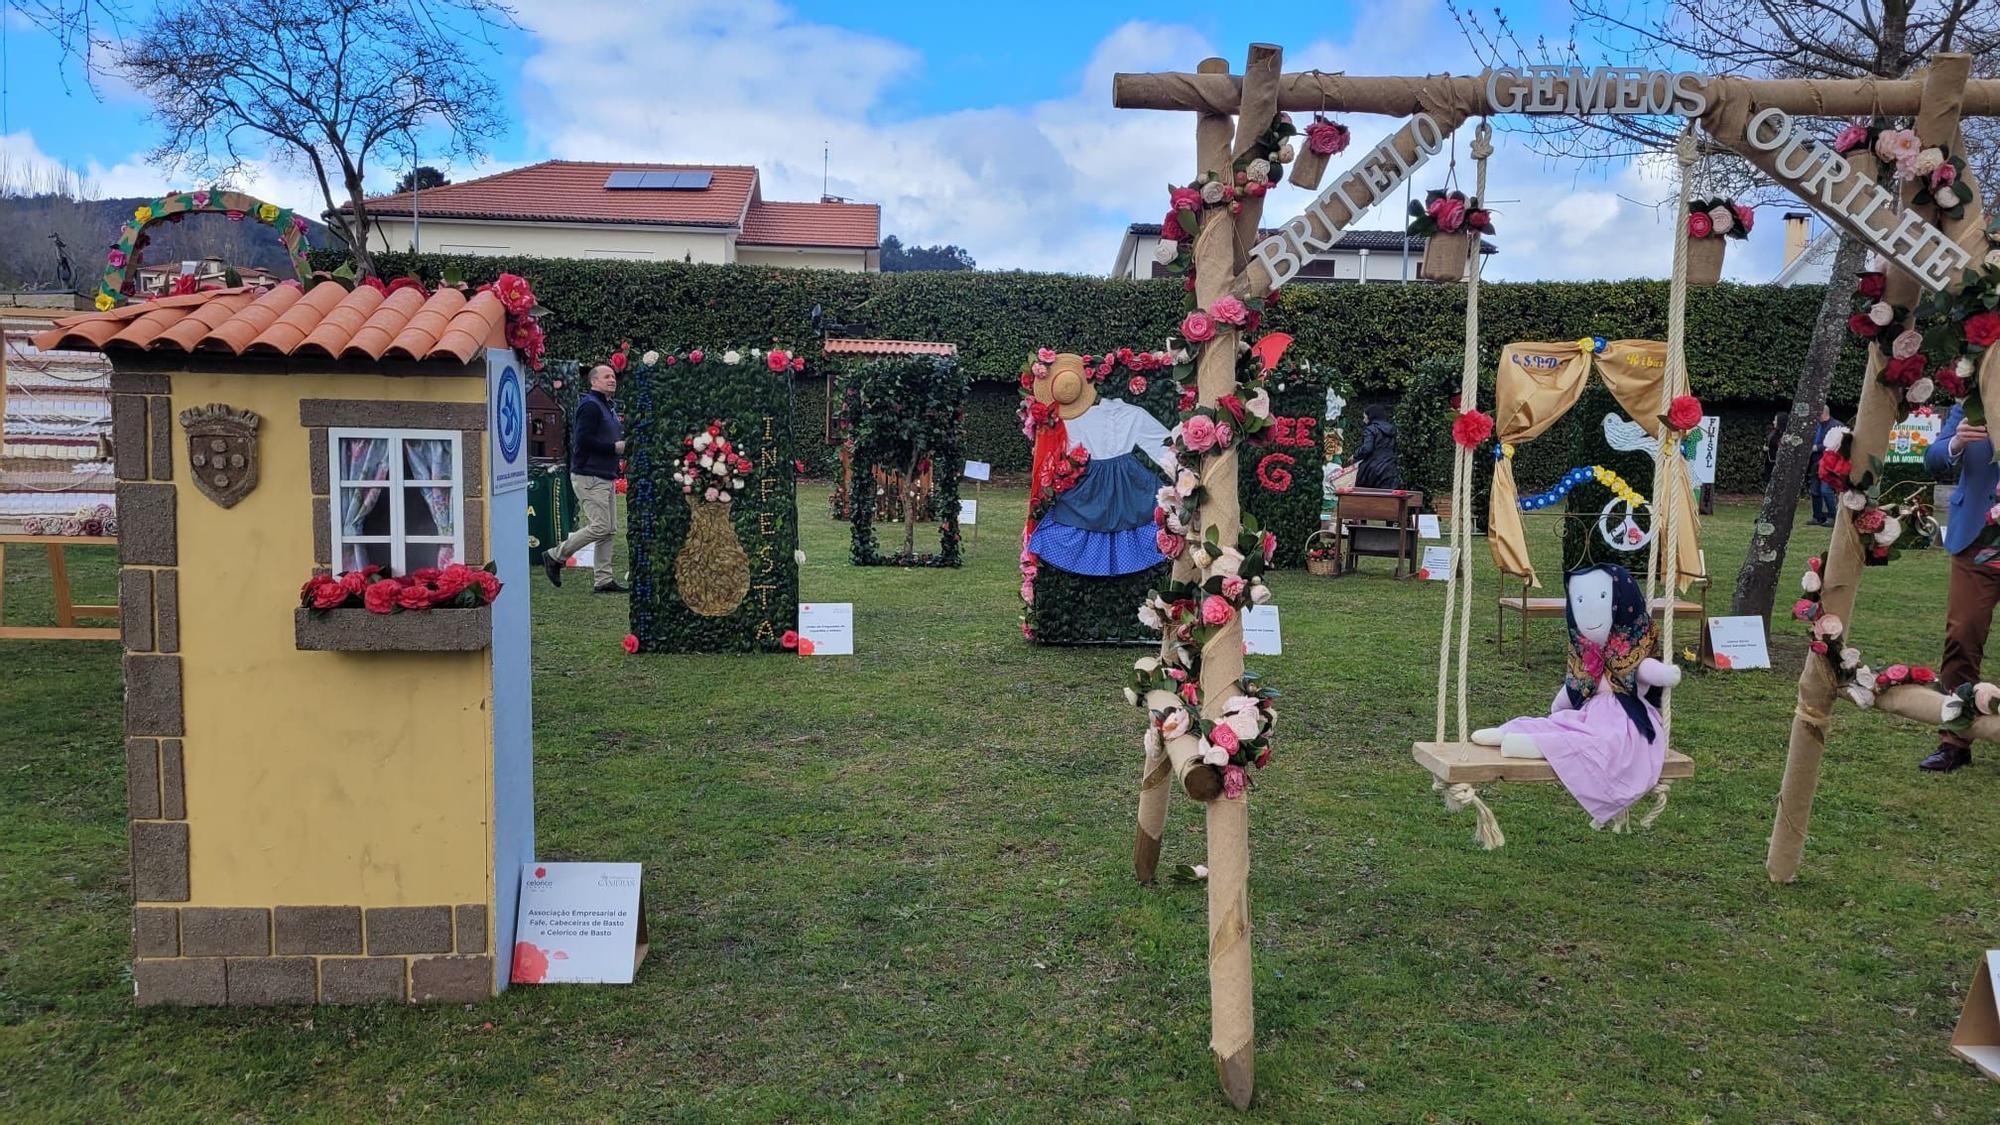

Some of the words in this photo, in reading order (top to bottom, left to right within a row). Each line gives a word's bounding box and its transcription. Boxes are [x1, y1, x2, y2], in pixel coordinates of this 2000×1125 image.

[1486, 65, 1709, 118] GEMEOS
[1248, 112, 1443, 291] BRITELO
[1746, 107, 1972, 292] OURILHE
[1705, 418, 1717, 468] FUTSAL
[1257, 453, 1297, 492] G
[752, 416, 779, 641] INFESTA
[528, 909, 570, 917] Associação
[571, 909, 616, 917] Empresarial
